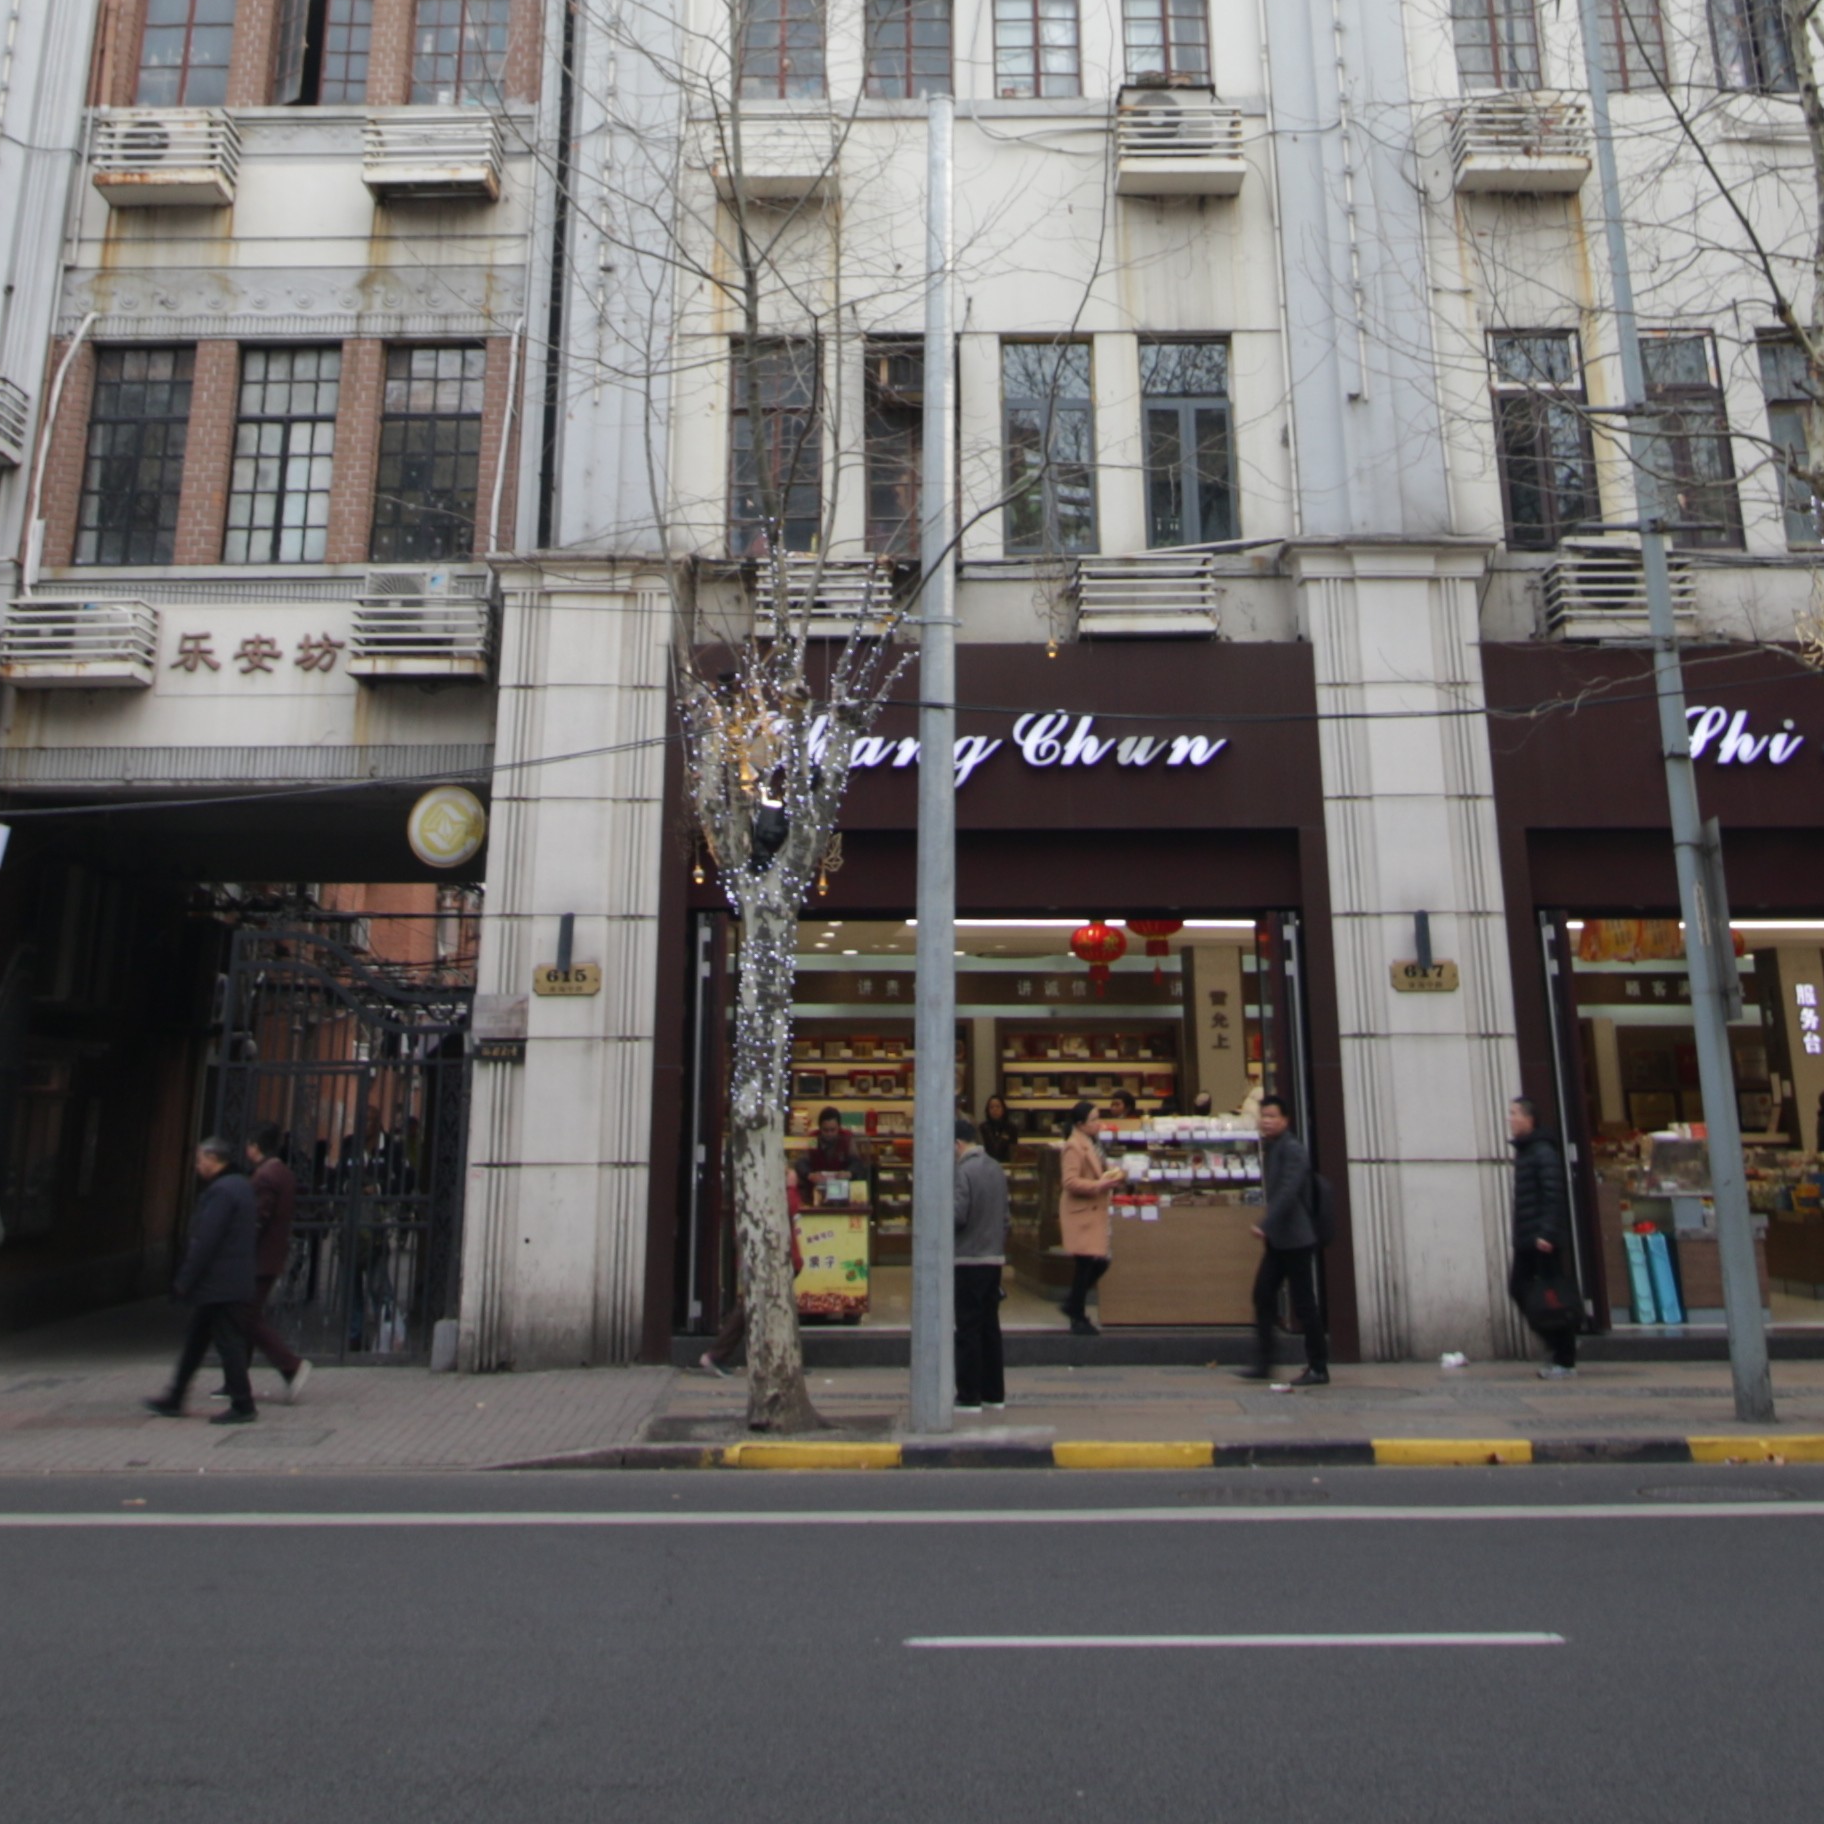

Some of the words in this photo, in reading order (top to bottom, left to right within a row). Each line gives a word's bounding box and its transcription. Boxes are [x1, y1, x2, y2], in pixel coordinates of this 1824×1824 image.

[169, 631, 346, 674] 乐安坊
[1012, 709, 1227, 768] Chun
[546, 969, 587, 983] 615
[1404, 964, 1444, 978] 617
[1208, 990, 1230, 1051] 雷允上
[1795, 983, 1822, 1054] 服务台
